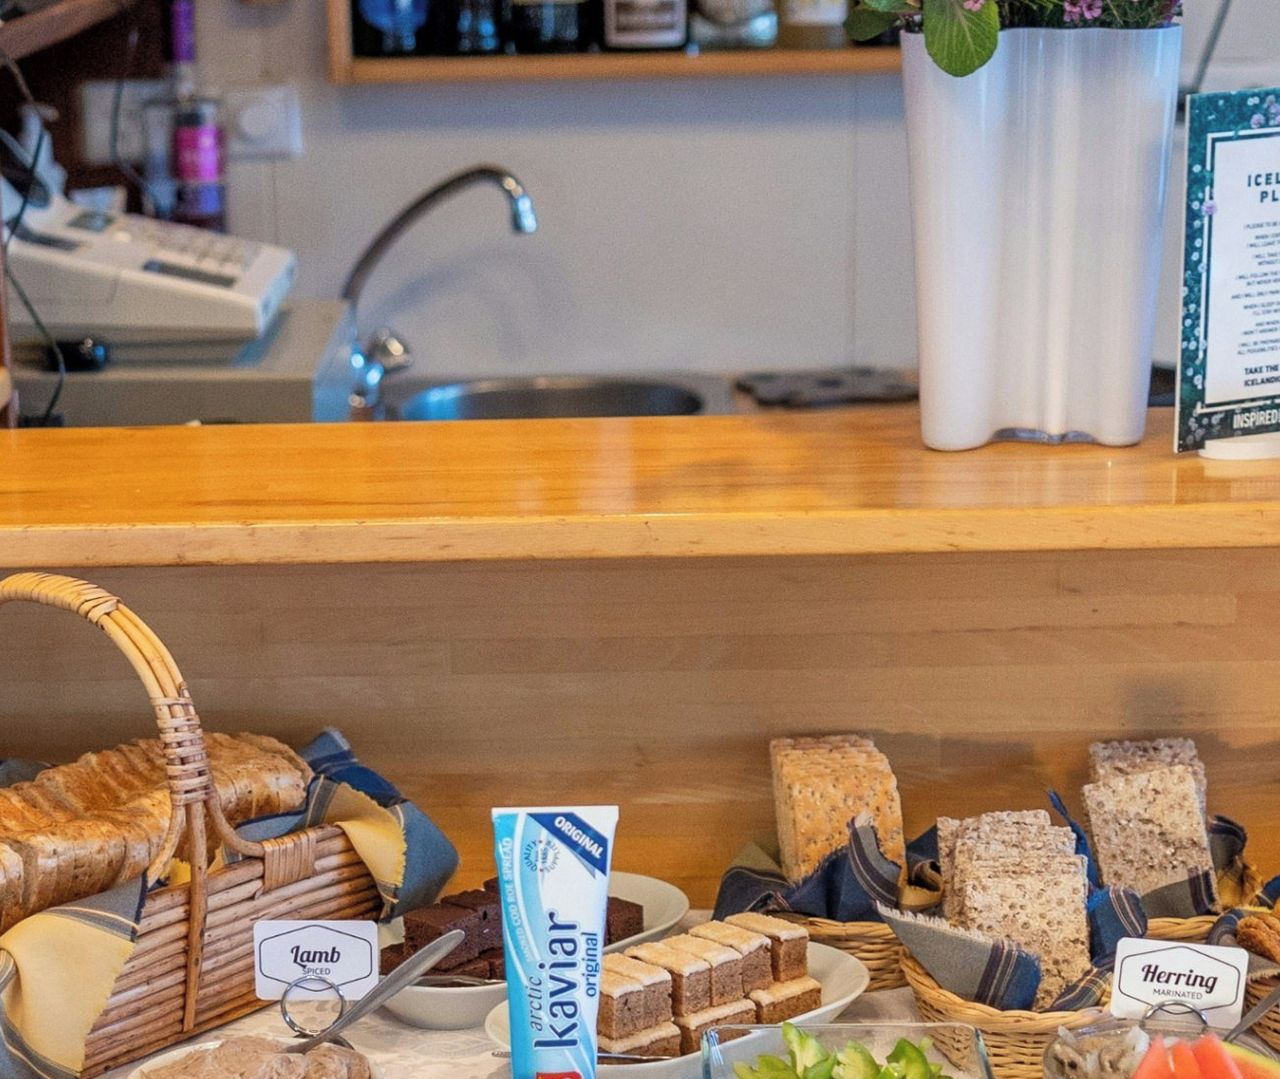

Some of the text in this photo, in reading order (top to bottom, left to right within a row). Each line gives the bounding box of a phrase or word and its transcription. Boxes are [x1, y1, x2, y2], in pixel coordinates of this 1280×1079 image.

[1244, 366, 1263, 376] TAKE
[1265, 364, 1279, 373] THE
[1233, 408, 1278, 429] INSPIRED
[553, 816, 604, 860] ORIGINAL
[290, 945, 341, 969] Lamb
[581, 932, 600, 997] original
[302, 967, 331, 975] SPICED
[526, 911, 578, 1048] arctic kaviar
[1141, 964, 1218, 994] Herring
[1152, 988, 1203, 1000] MARINATED
